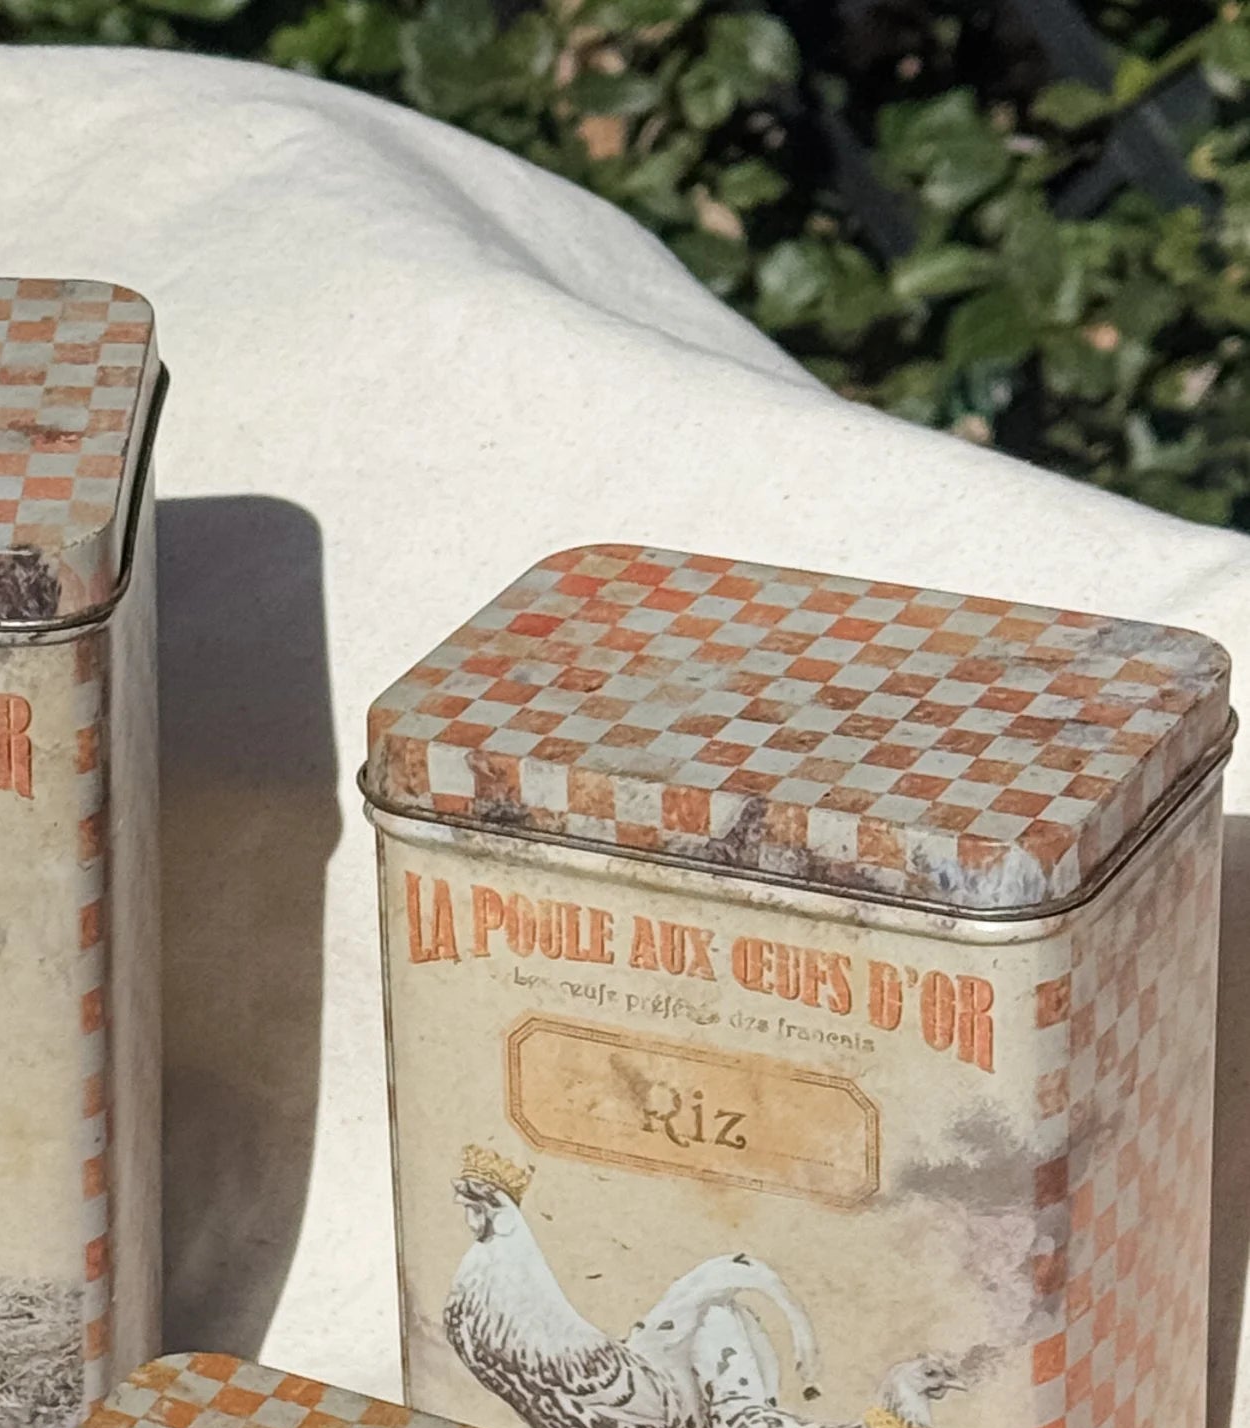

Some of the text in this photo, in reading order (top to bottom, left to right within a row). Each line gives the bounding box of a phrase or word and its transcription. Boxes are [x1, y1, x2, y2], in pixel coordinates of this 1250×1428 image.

[405, 871, 461, 964] LA
[469, 884, 616, 965] POULE
[628, 915, 717, 981] AUX
[867, 959, 996, 1074] D'OR
[640, 1081, 748, 1150] Riz
